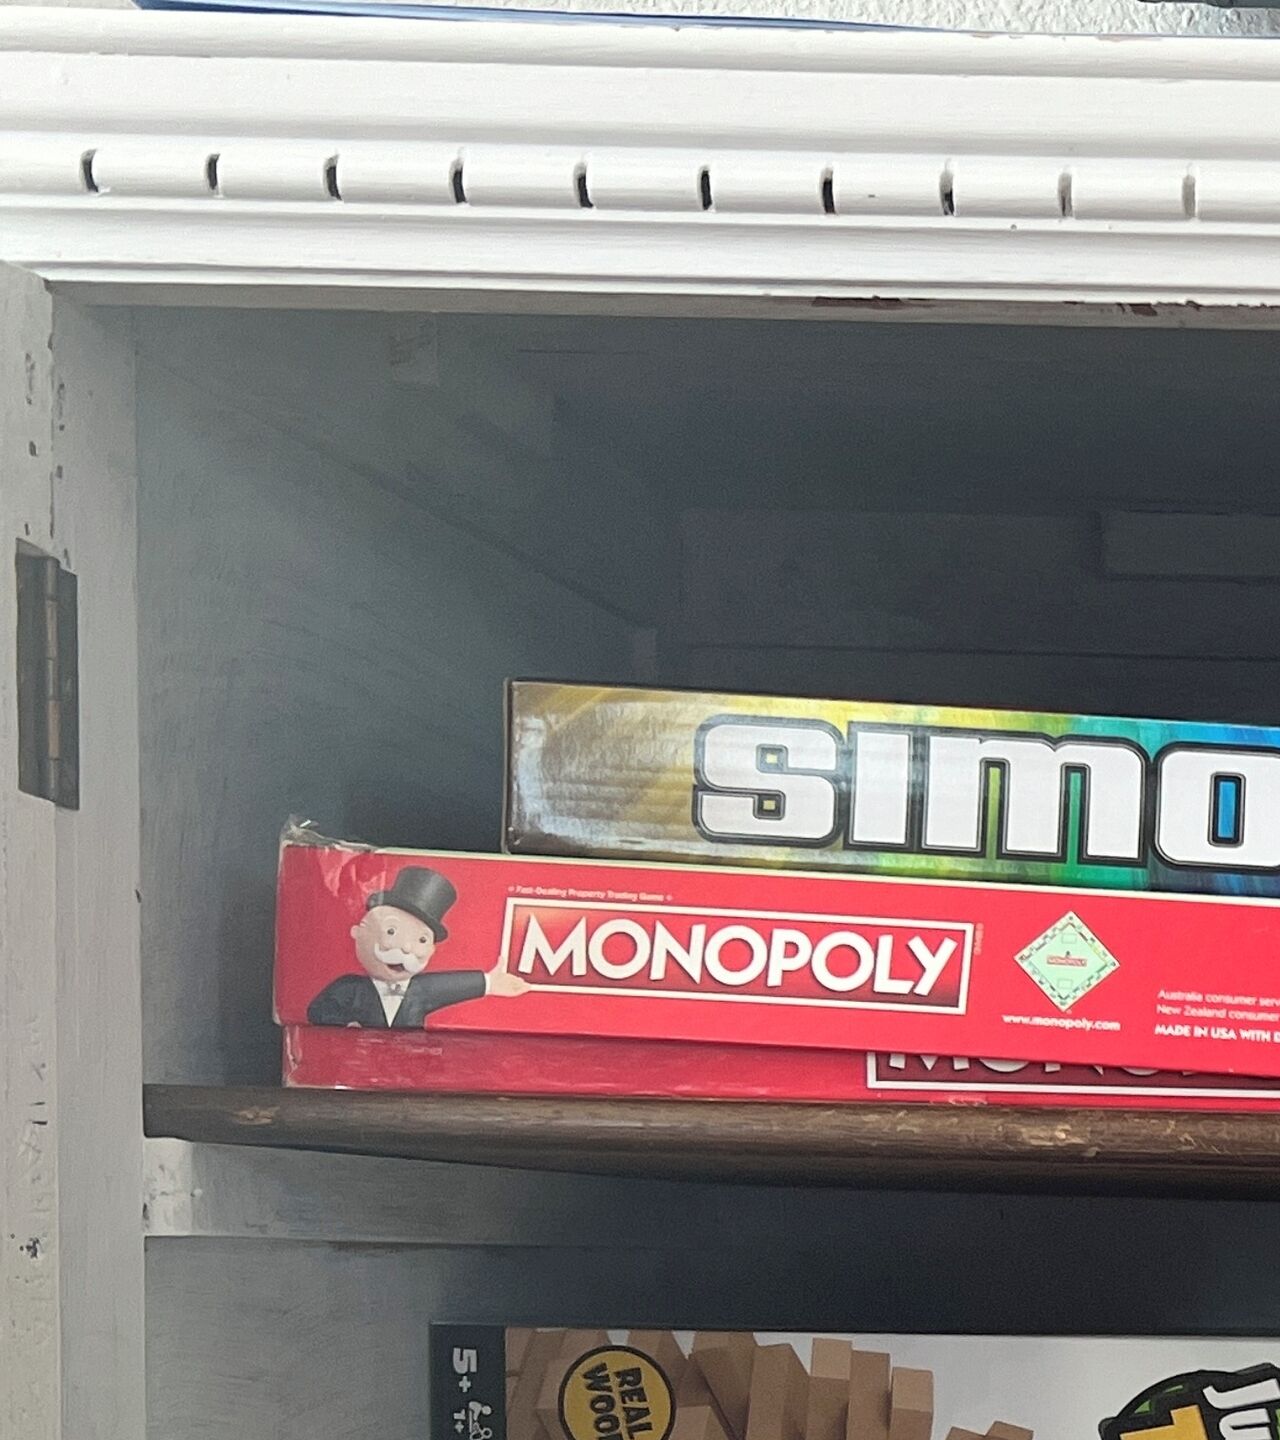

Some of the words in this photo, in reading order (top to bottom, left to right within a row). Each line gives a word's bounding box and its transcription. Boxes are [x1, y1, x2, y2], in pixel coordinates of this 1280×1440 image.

[517, 914, 958, 997] MONOPOLY
[1001, 1013, 1121, 1031] www.monopoly.com
[452, 1347, 477, 1393] 5+
[615, 1366, 654, 1440] REAL
